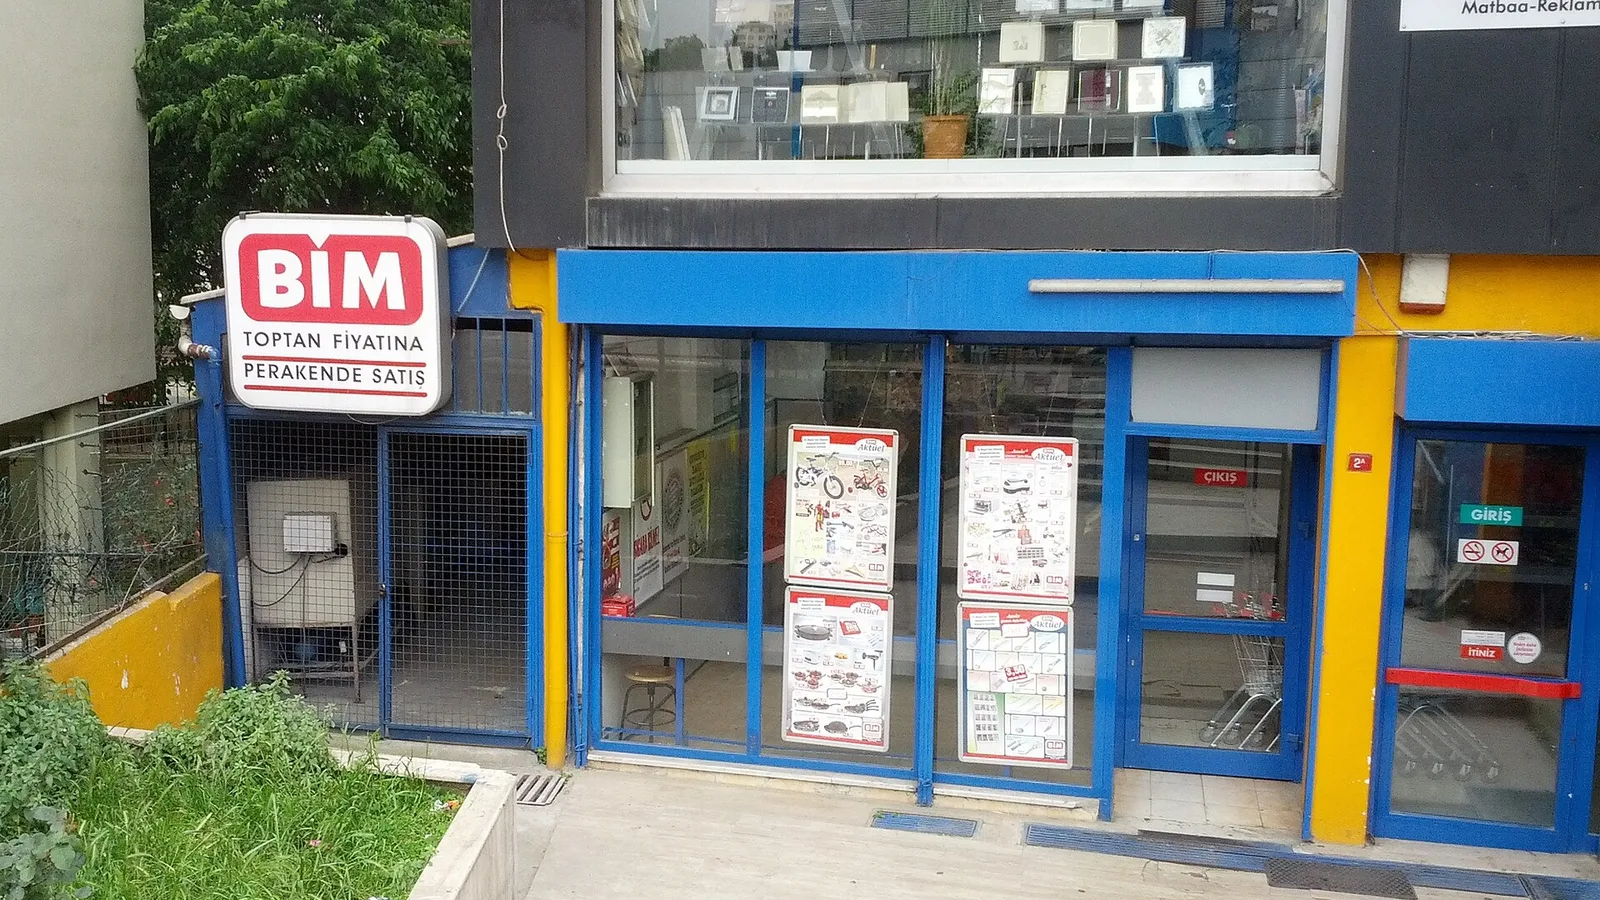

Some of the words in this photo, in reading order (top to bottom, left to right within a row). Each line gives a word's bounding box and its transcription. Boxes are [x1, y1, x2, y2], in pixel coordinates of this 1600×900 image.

[1461, 0, 1600, 14] Matbaa-Reklam
[257, 247, 406, 310] BİM
[243, 331, 321, 348] TOPTAN
[333, 330, 424, 351] FİYATINA
[244, 363, 362, 383] PERAKENDE
[372, 368, 425, 390] SATIŞ
[1203, 471, 1238, 485] ÇIKIŞ
[1471, 507, 1512, 524] GİRİŞ
[1468, 646, 1496, 658] İTİNİZ
